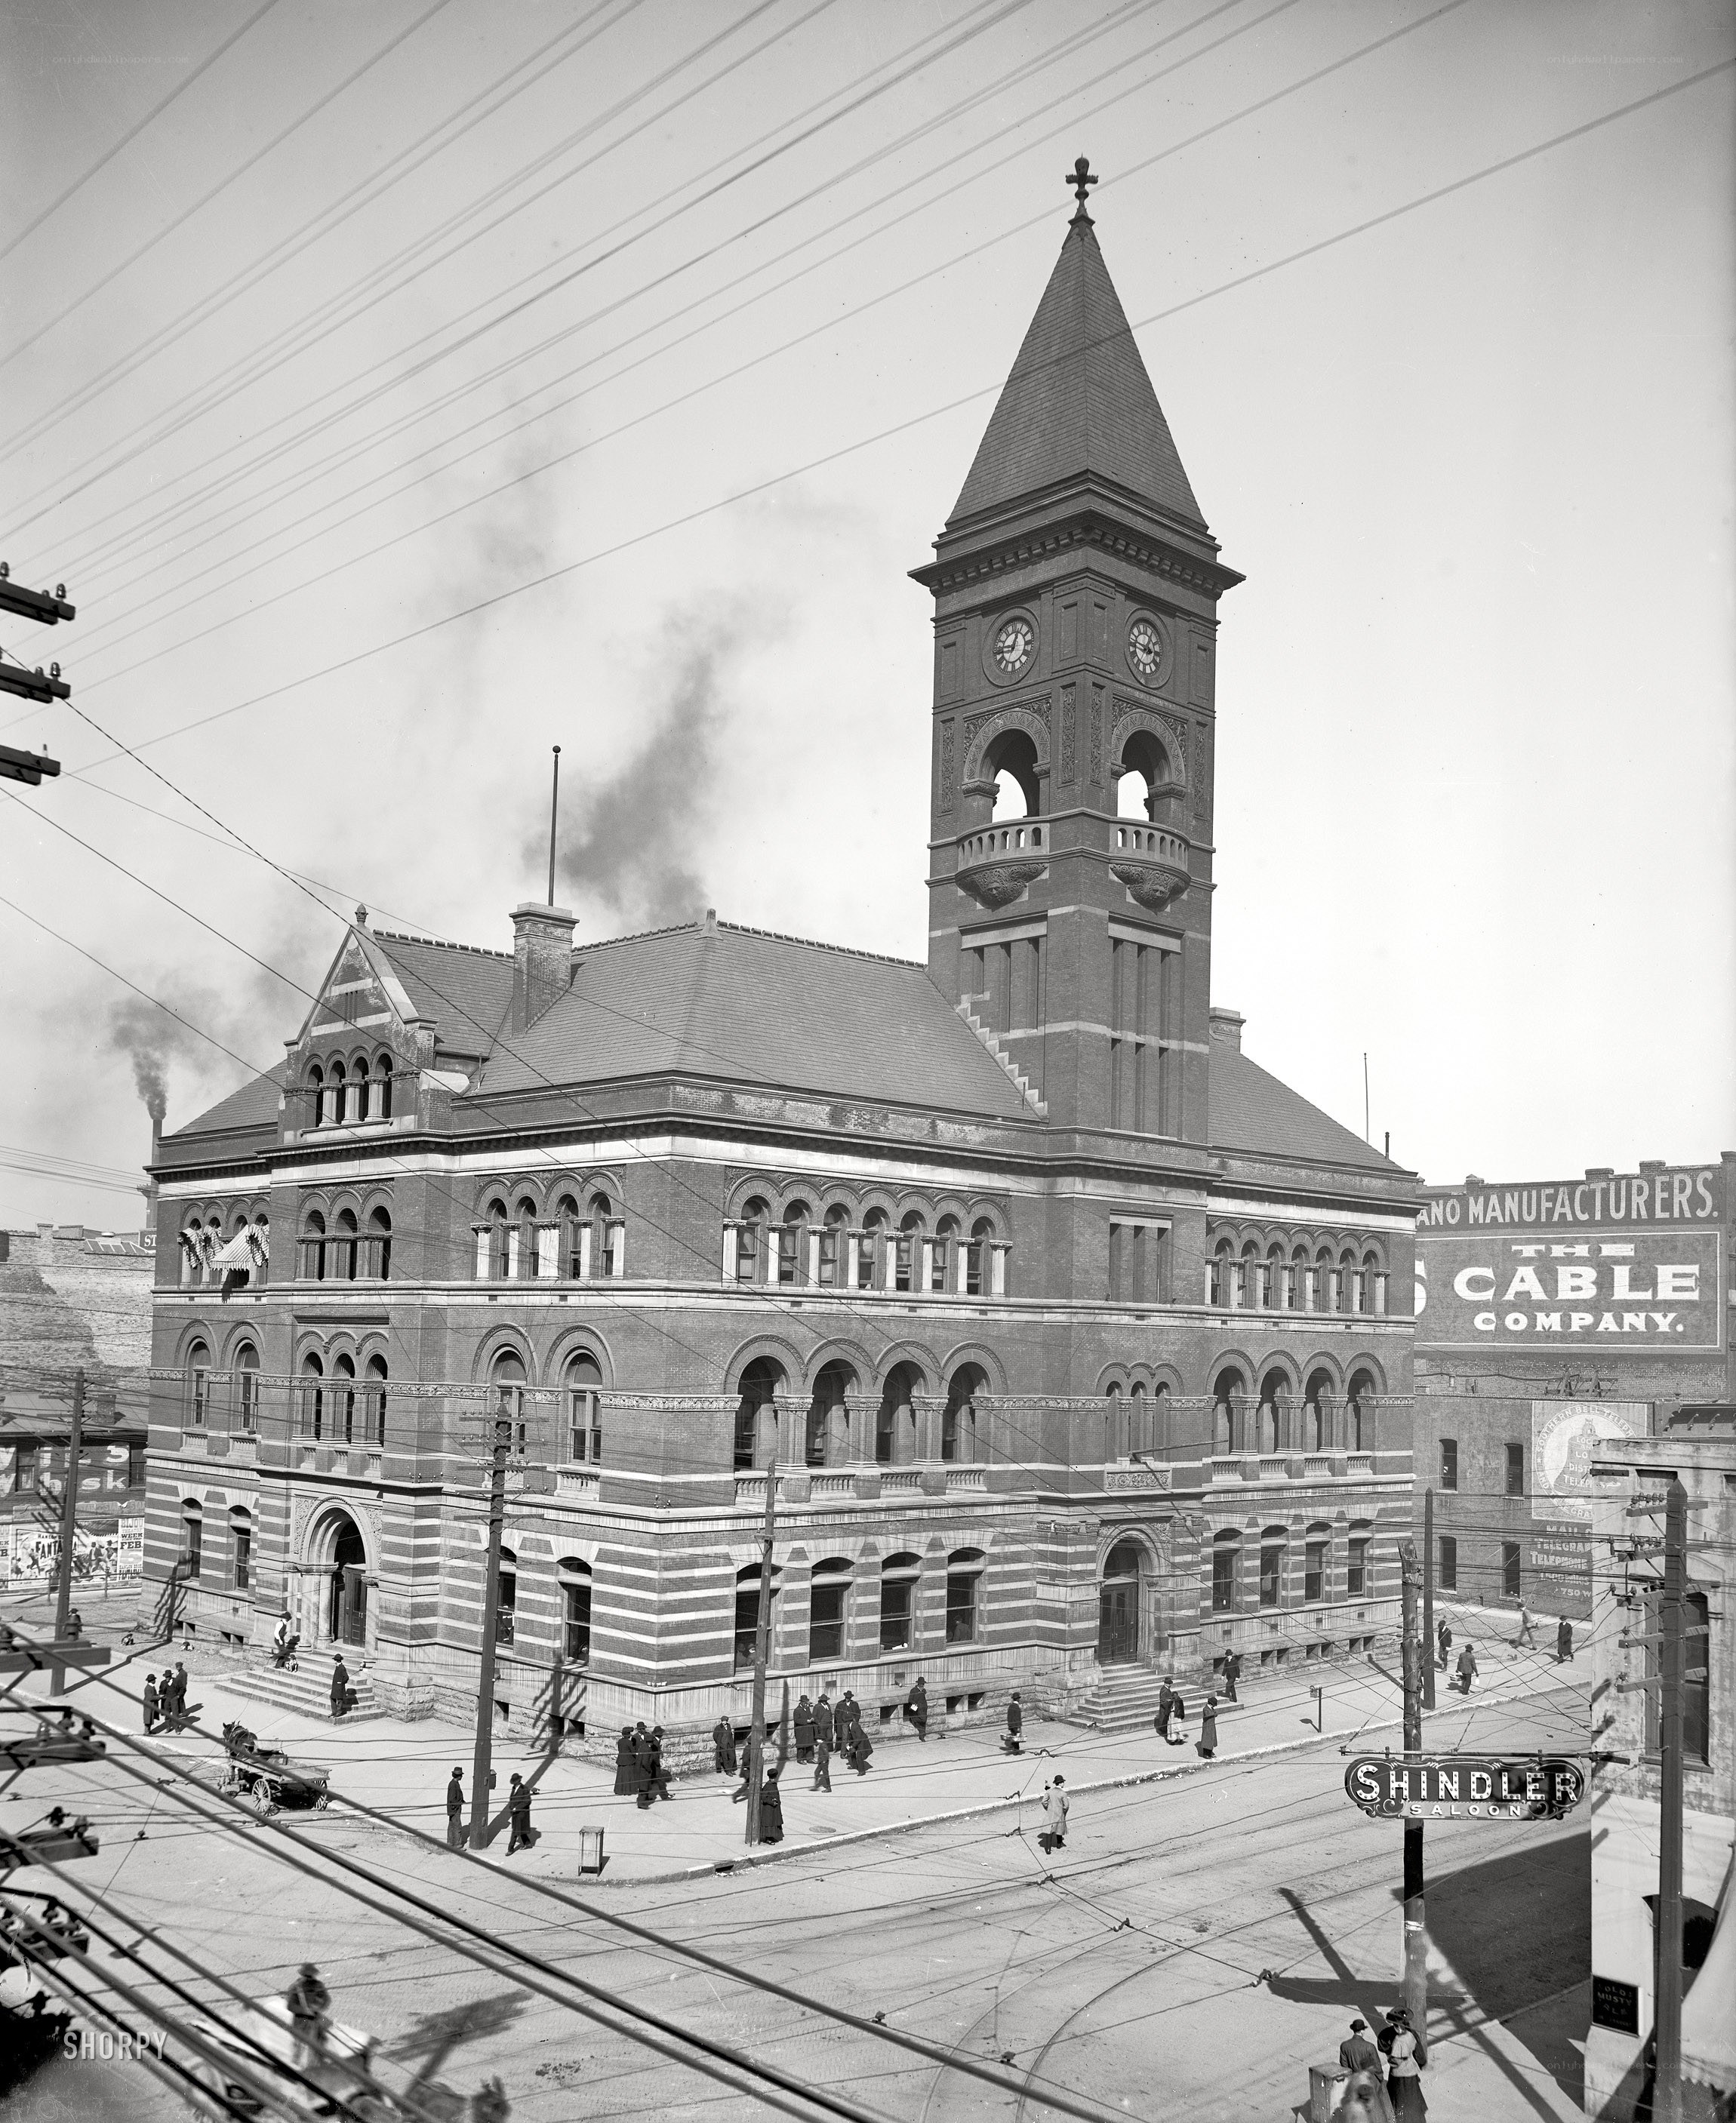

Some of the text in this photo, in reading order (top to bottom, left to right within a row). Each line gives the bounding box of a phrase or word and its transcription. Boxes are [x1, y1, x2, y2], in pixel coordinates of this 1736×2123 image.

[1468, 1171, 1719, 1223] MANUFACTURERS.
[1511, 1244, 1635, 1257] THE
[1454, 1264, 1700, 1301] CABLE
[1473, 1312, 1684, 1331] COMPANY.
[120, 1540, 143, 1549] FEB.
[1530, 1551, 1588, 1569] TELEPHONE
[1356, 1765, 1577, 1801] SHINDLER
[1410, 1804, 1521, 1816] SALOON
